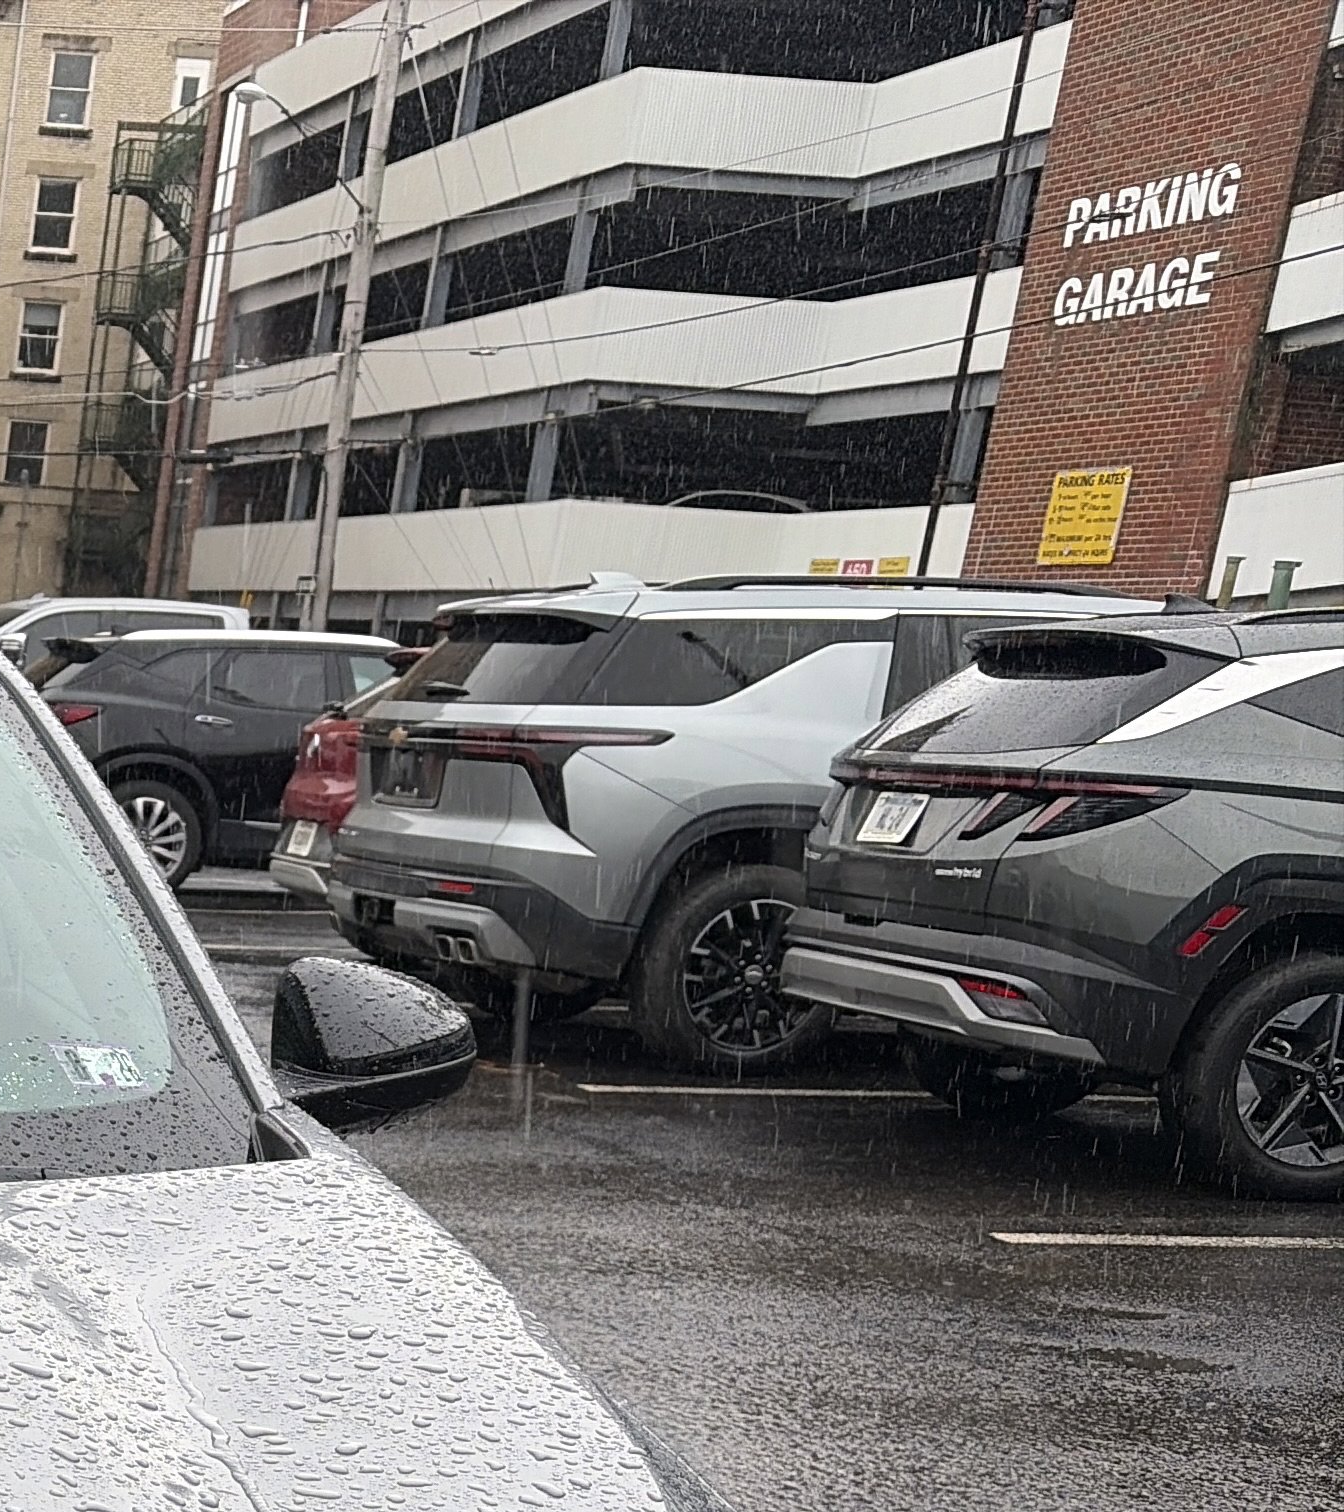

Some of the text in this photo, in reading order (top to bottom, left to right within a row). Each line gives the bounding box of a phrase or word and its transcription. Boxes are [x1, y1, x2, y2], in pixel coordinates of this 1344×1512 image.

[1062, 162, 1243, 249] PARKING
[1053, 250, 1221, 327] GARAGE
[1057, 473, 1126, 487] PARKING RATES
